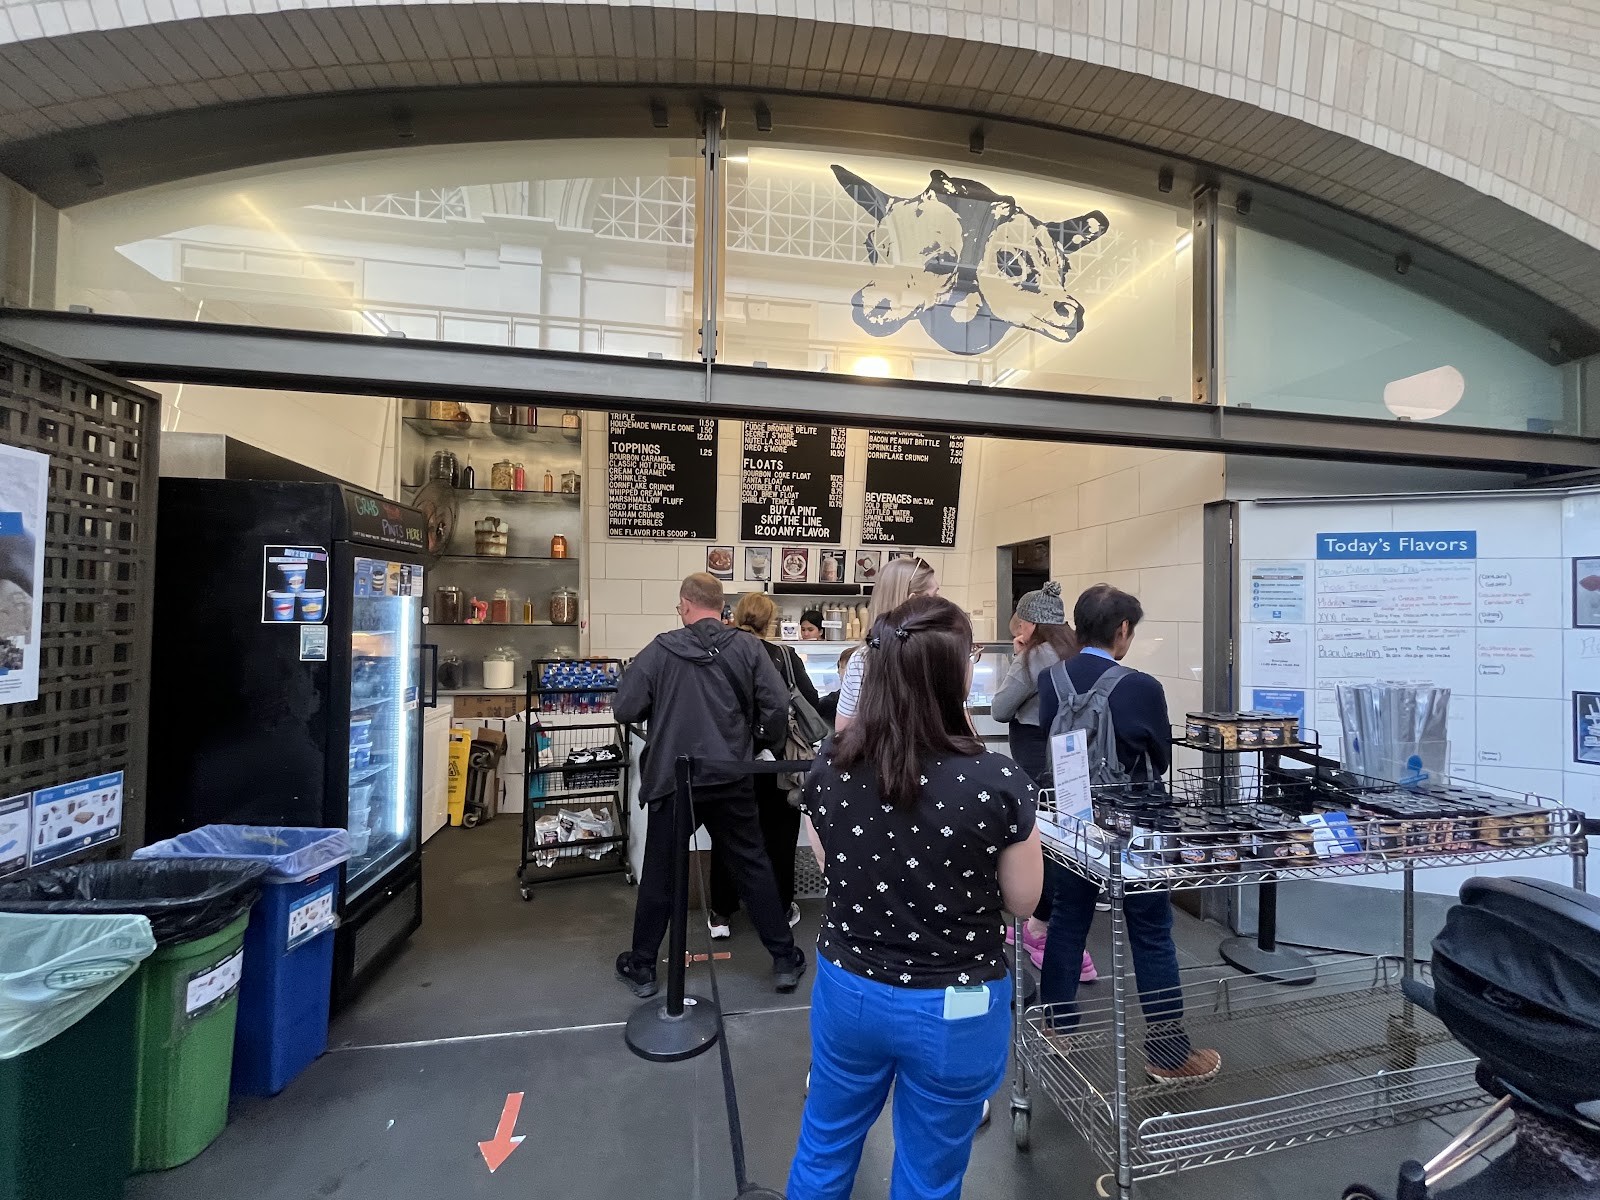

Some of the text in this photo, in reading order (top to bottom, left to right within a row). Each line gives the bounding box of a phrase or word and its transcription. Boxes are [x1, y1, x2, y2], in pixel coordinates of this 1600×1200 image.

[610, 413, 714, 427] TRIPLE 11.50
[610, 420, 649, 429] HOUSEMADE
[650, 422, 676, 431] WAFFLE
[678, 424, 694, 432] CONE
[767, 425, 794, 433] BROWNIE
[795, 426, 817, 435] DELITE
[745, 430, 769, 438] SECRET
[772, 431, 794, 440] S'MORE
[774, 439, 798, 447] SUNDAE
[890, 437, 914, 445] PEANUT
[914, 438, 940, 447] BRITTLE
[612, 442, 660, 454] TOPPINGS
[764, 445, 787, 453] S'MORE
[868, 444, 902, 452] SPRINKLES
[609, 453, 671, 463] BOURBON CARAMEL
[868, 452, 904, 460] CORNFLAKE
[904, 454, 929, 462] CRUNCH
[654, 463, 675, 471] FUDGE
[744, 458, 783, 470] FLOATS
[635, 469, 667, 477] CARAMEL
[792, 472, 811, 480] FLOAT
[649, 483, 675, 491] CRUNCH
[866, 492, 912, 504] BEVERAGES
[354, 496, 379, 516] GRAB
[770, 505, 817, 516] BUY A PINT
[761, 514, 822, 526] SKIP THE LINE
[382, 519, 404, 538] PINTS
[778, 526, 795, 536] ANY
[796, 527, 830, 538] FLAVOR
[1324, 538, 1468, 555] Today's Flavors
[64, 784, 89, 794] RECYCLE
